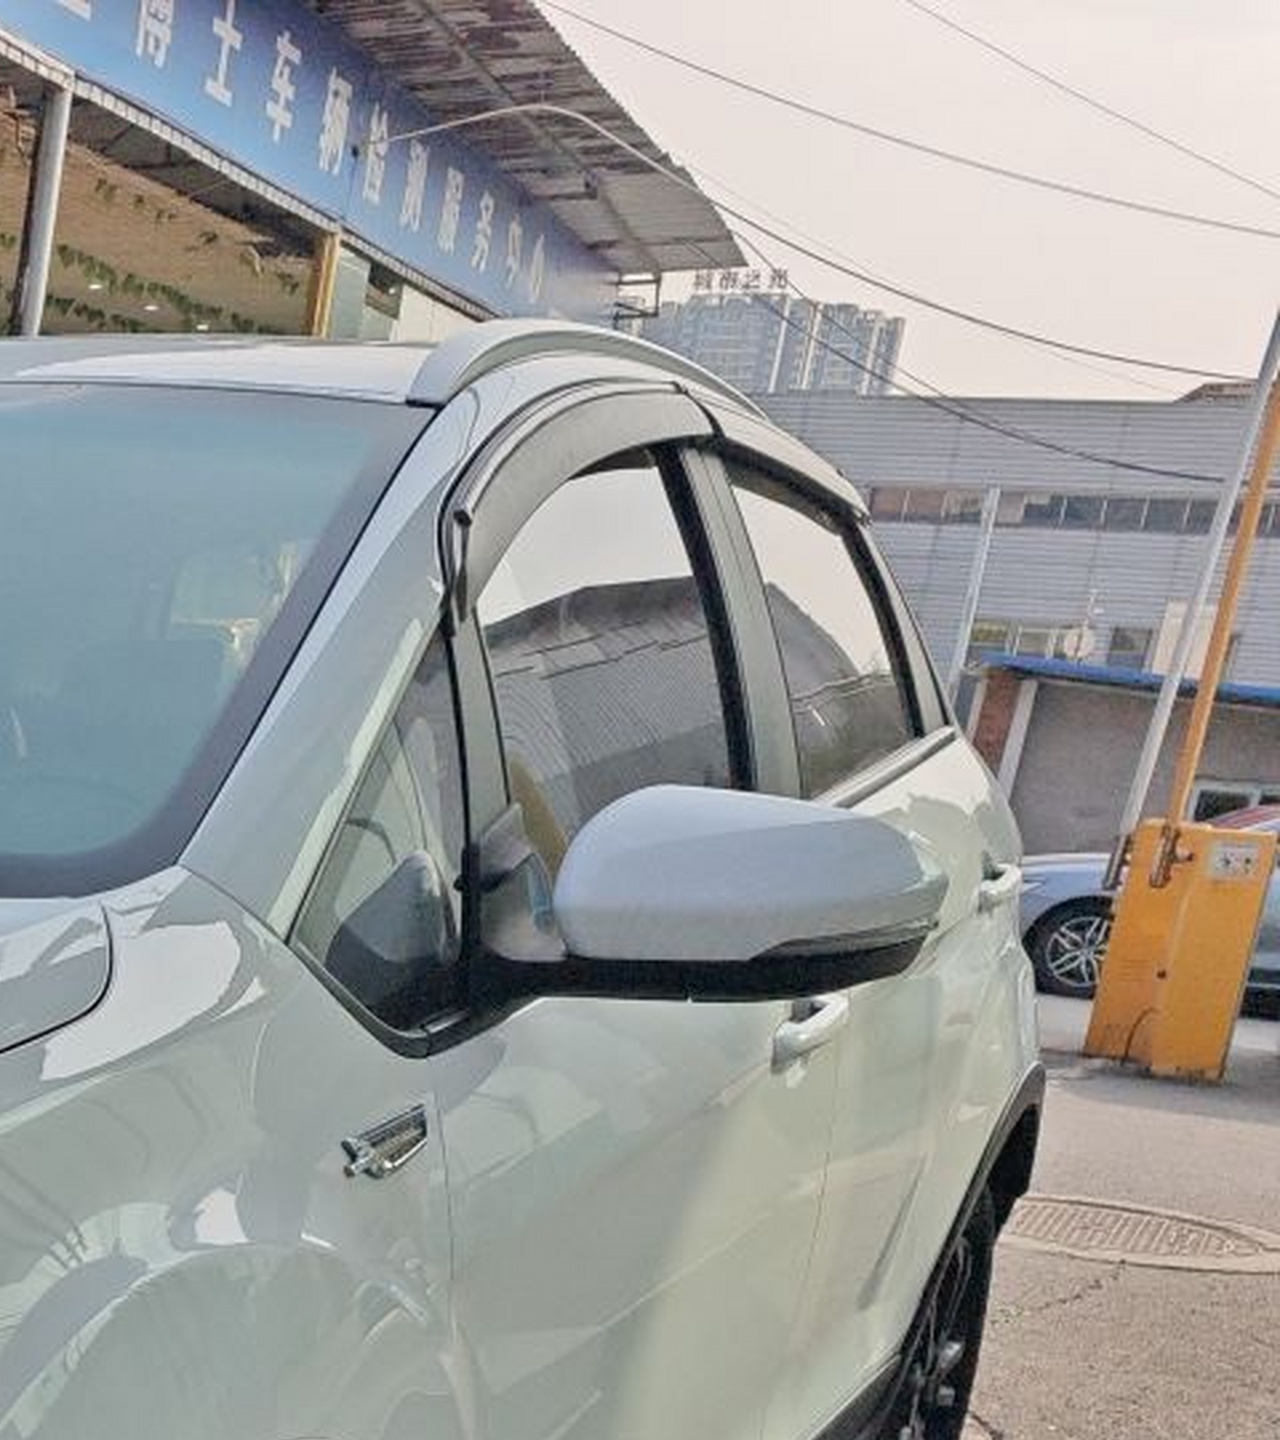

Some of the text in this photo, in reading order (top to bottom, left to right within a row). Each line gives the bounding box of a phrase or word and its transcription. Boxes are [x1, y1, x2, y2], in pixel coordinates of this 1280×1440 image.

[55, 0, 545, 303] 博士车辆检测服务中心
